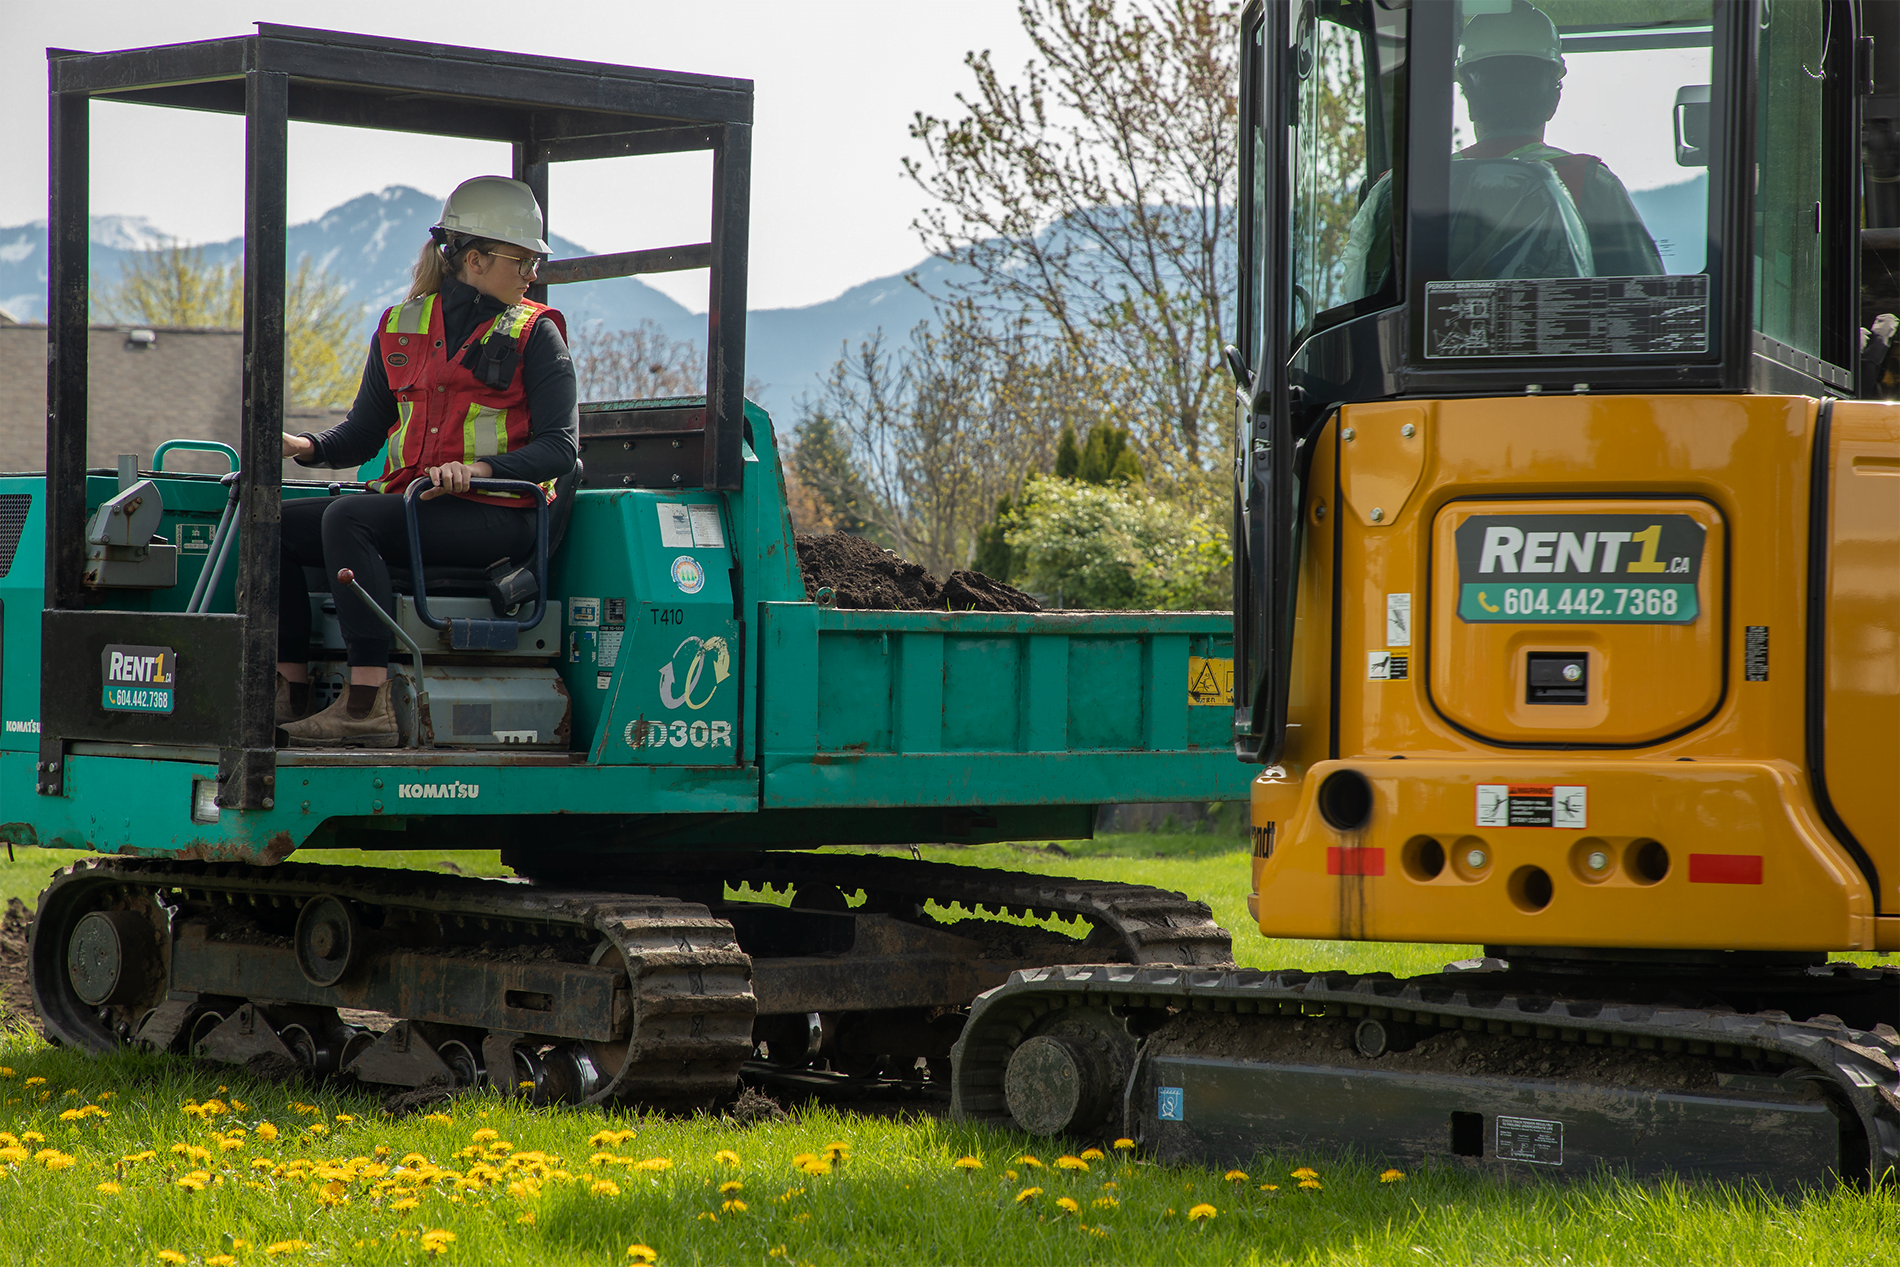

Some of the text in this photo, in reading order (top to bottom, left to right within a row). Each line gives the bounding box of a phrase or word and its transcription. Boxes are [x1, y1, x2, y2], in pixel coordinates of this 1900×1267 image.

[1504, 588, 1679, 616] 604.442.7368
[650, 608, 684, 625] T410
[116, 689, 168, 709] 604.442.7368
[6, 719, 42, 733] KOMATSU
[398, 780, 479, 799] KOMATSU
